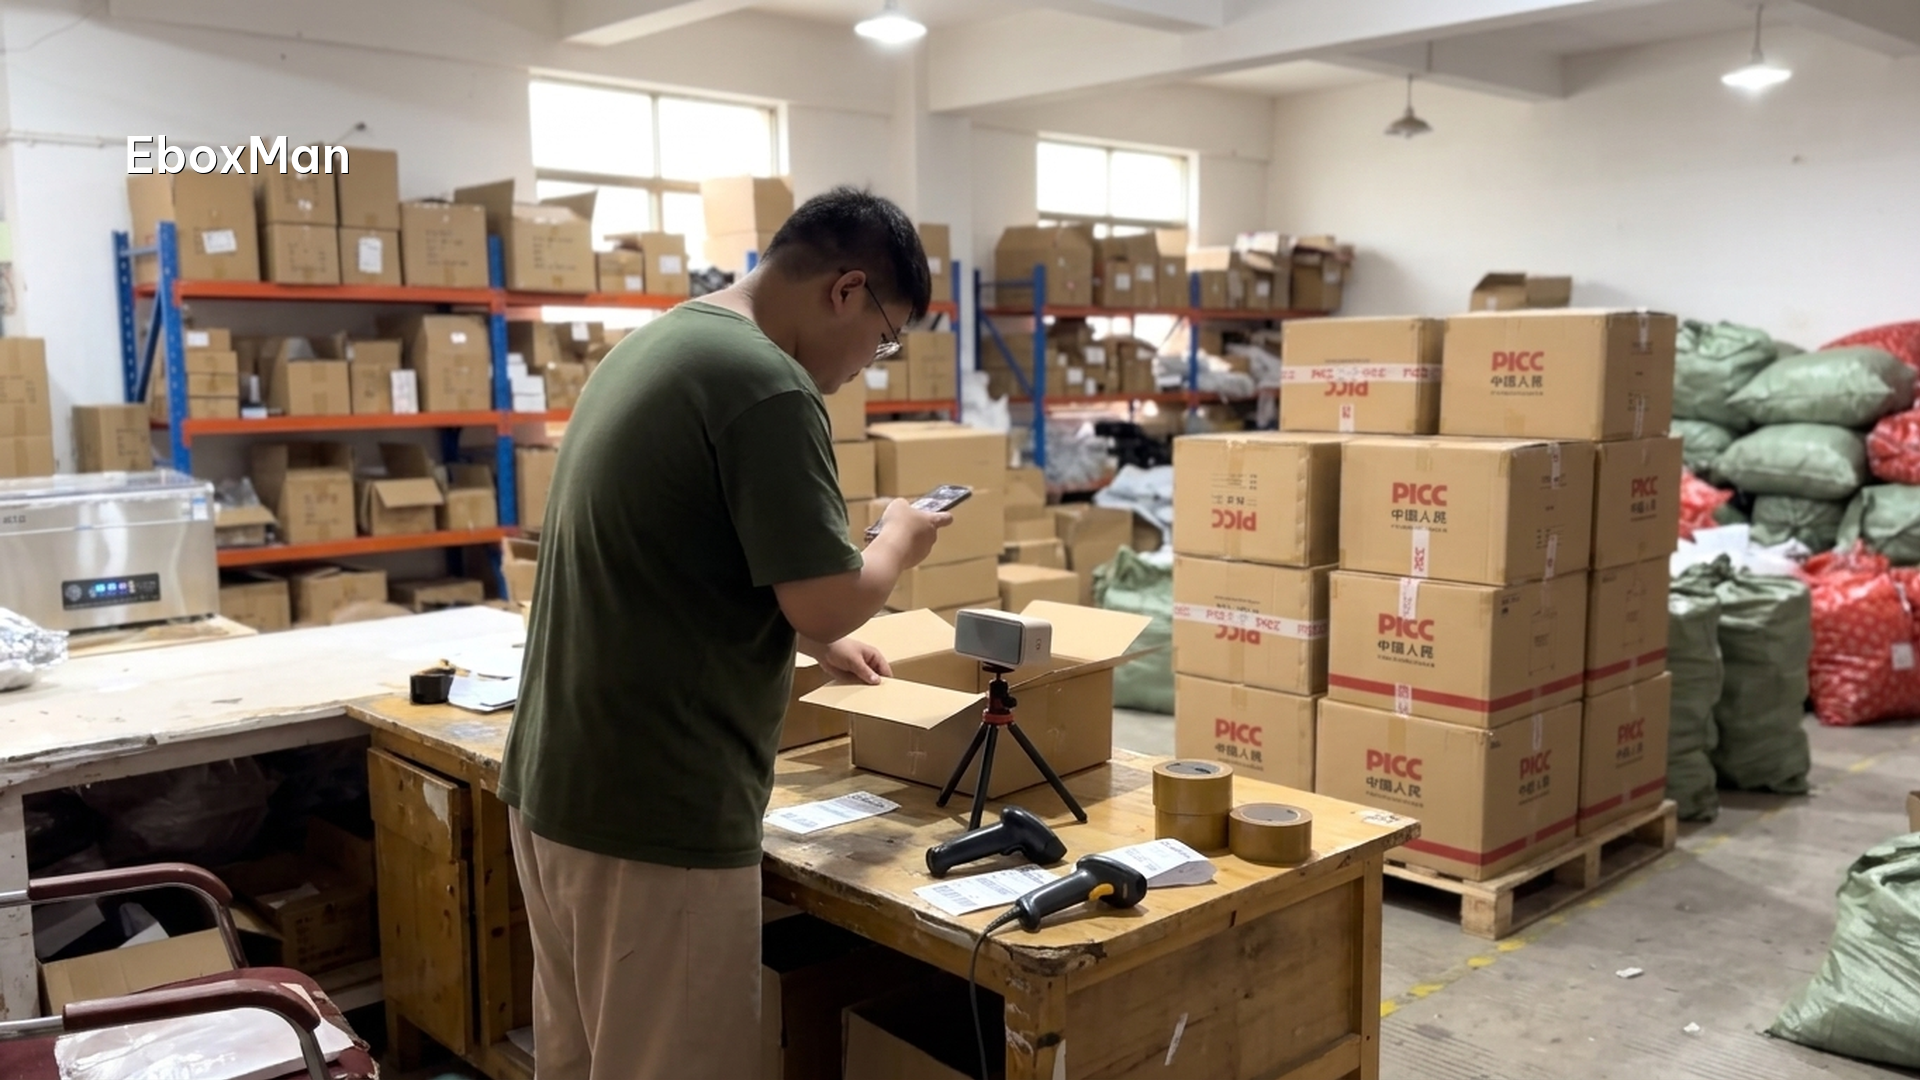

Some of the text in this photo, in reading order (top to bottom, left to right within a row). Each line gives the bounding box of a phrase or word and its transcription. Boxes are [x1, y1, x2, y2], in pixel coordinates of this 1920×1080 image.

[1492, 351, 1545, 371] PICC
[1392, 482, 1448, 507] PICC
[1211, 509, 1257, 531] PICC
[1378, 613, 1435, 642] PICC
[1215, 718, 1263, 747] PICC
[1366, 749, 1423, 782] PICC
[1520, 749, 1552, 780] PICC
